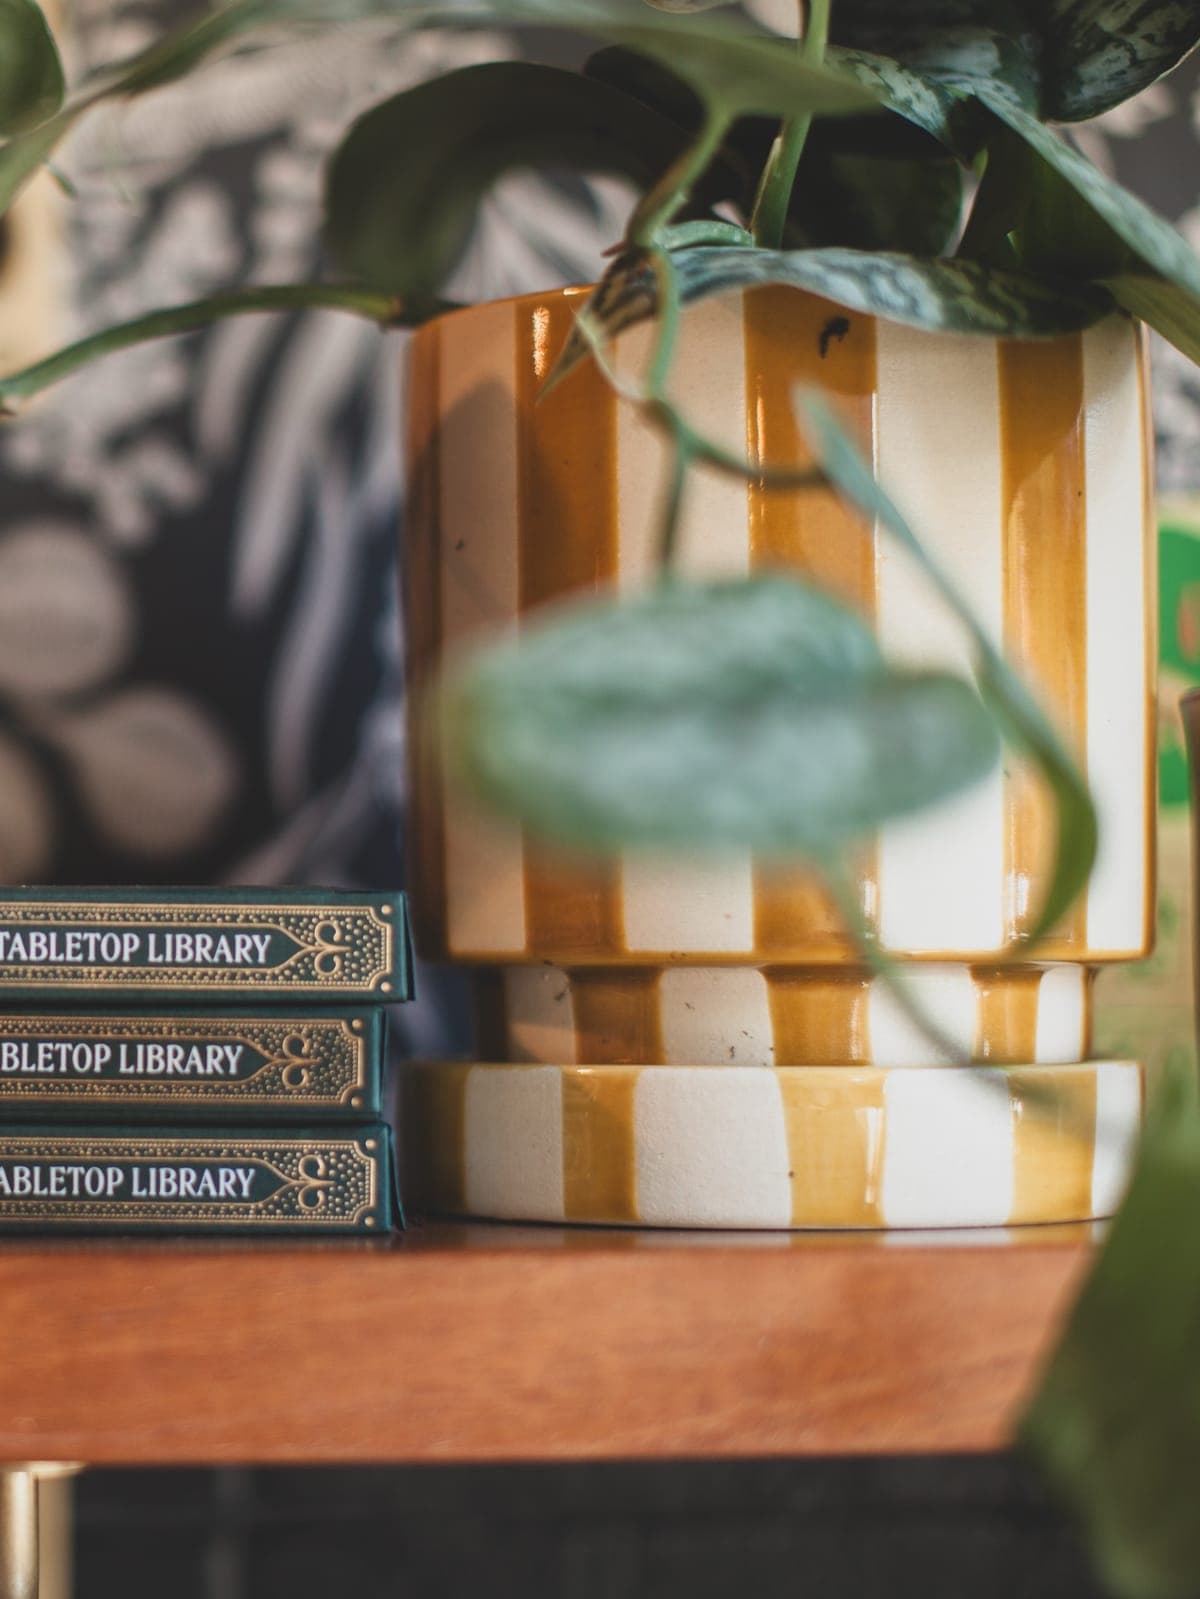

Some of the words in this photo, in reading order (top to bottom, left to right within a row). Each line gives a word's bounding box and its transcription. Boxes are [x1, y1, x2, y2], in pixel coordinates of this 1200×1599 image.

[147, 932, 272, 965] LIBRARY
[119, 1043, 244, 1075] LIBRARY
[131, 1167, 256, 1198] LIBRARY
